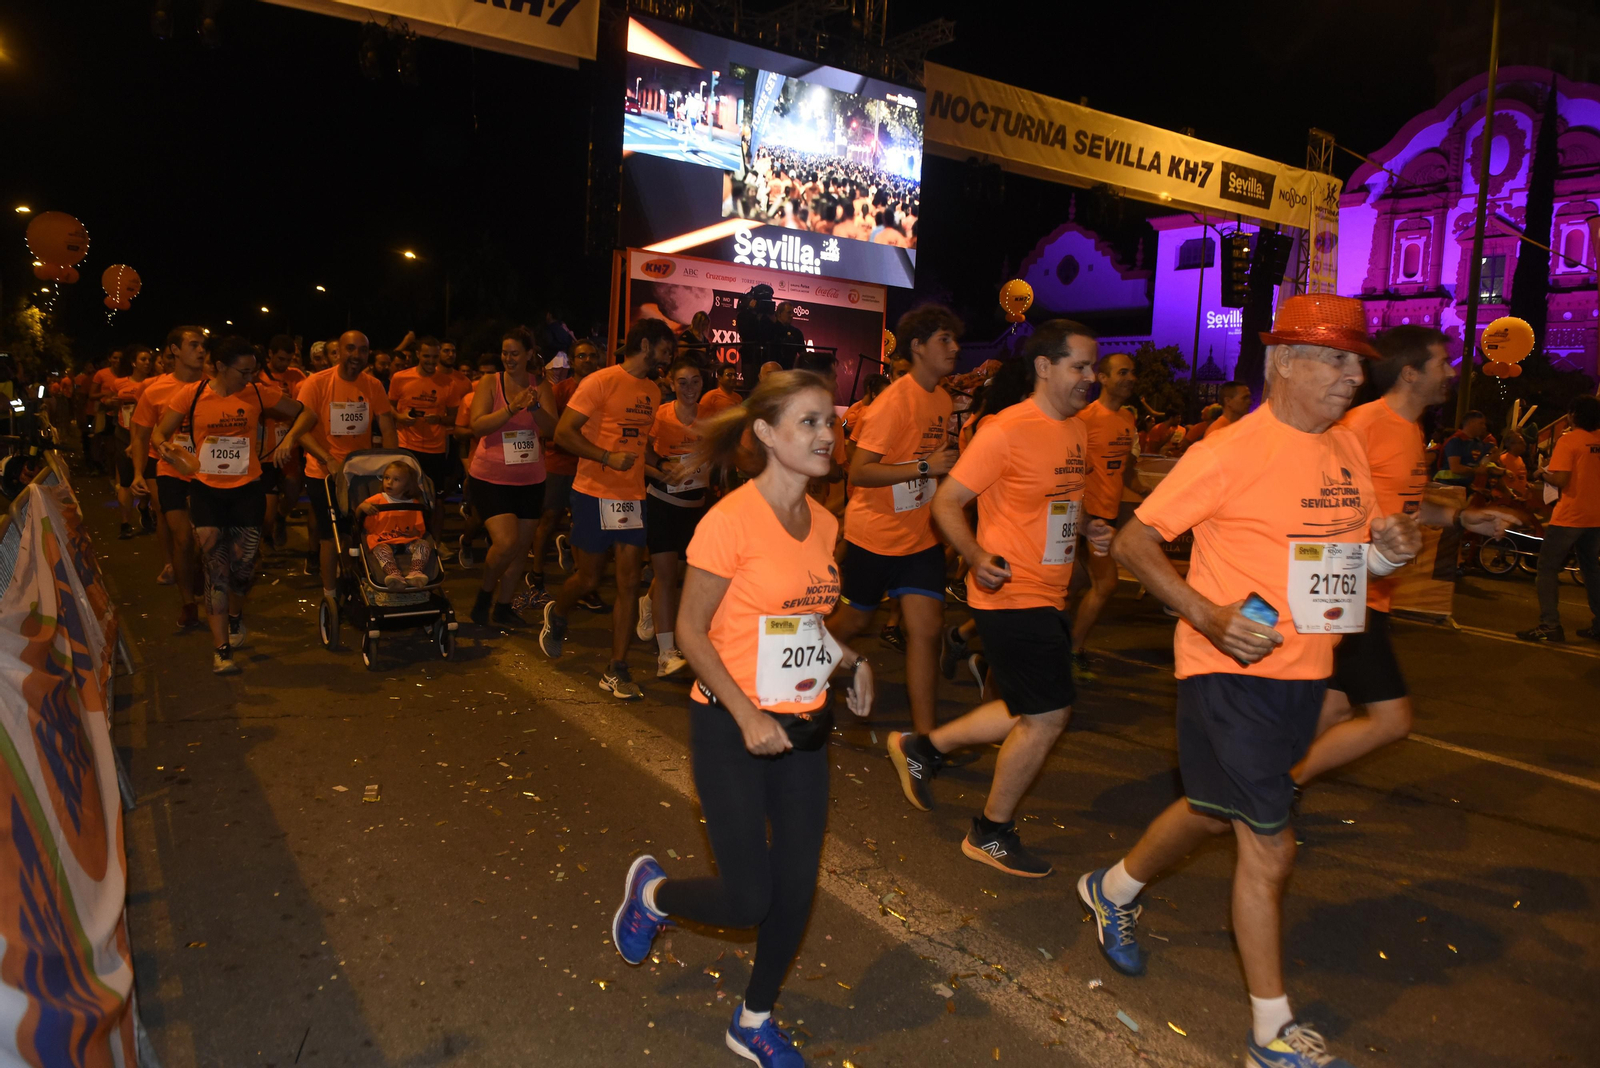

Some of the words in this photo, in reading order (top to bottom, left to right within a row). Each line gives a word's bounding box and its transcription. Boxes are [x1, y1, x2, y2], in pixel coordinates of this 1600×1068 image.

[929, 90, 1067, 150] NOCTURNA
[1073, 129, 1161, 174] SEVILLA
[683, 267, 698, 276] ABC
[705, 271, 737, 283] Cruzcampo
[340, 413, 364, 422] 12055
[512, 440, 535, 450] 10389
[210, 448, 240, 460] 12054
[1054, 467, 1075, 475] SEVILLA
[1320, 487, 1360, 497] NOCTURNA
[610, 502, 635, 513] 12656
[1301, 498, 1340, 508] SEVILLA
[1309, 573, 1357, 595] 21762
[782, 595, 823, 609] SEVILLA
